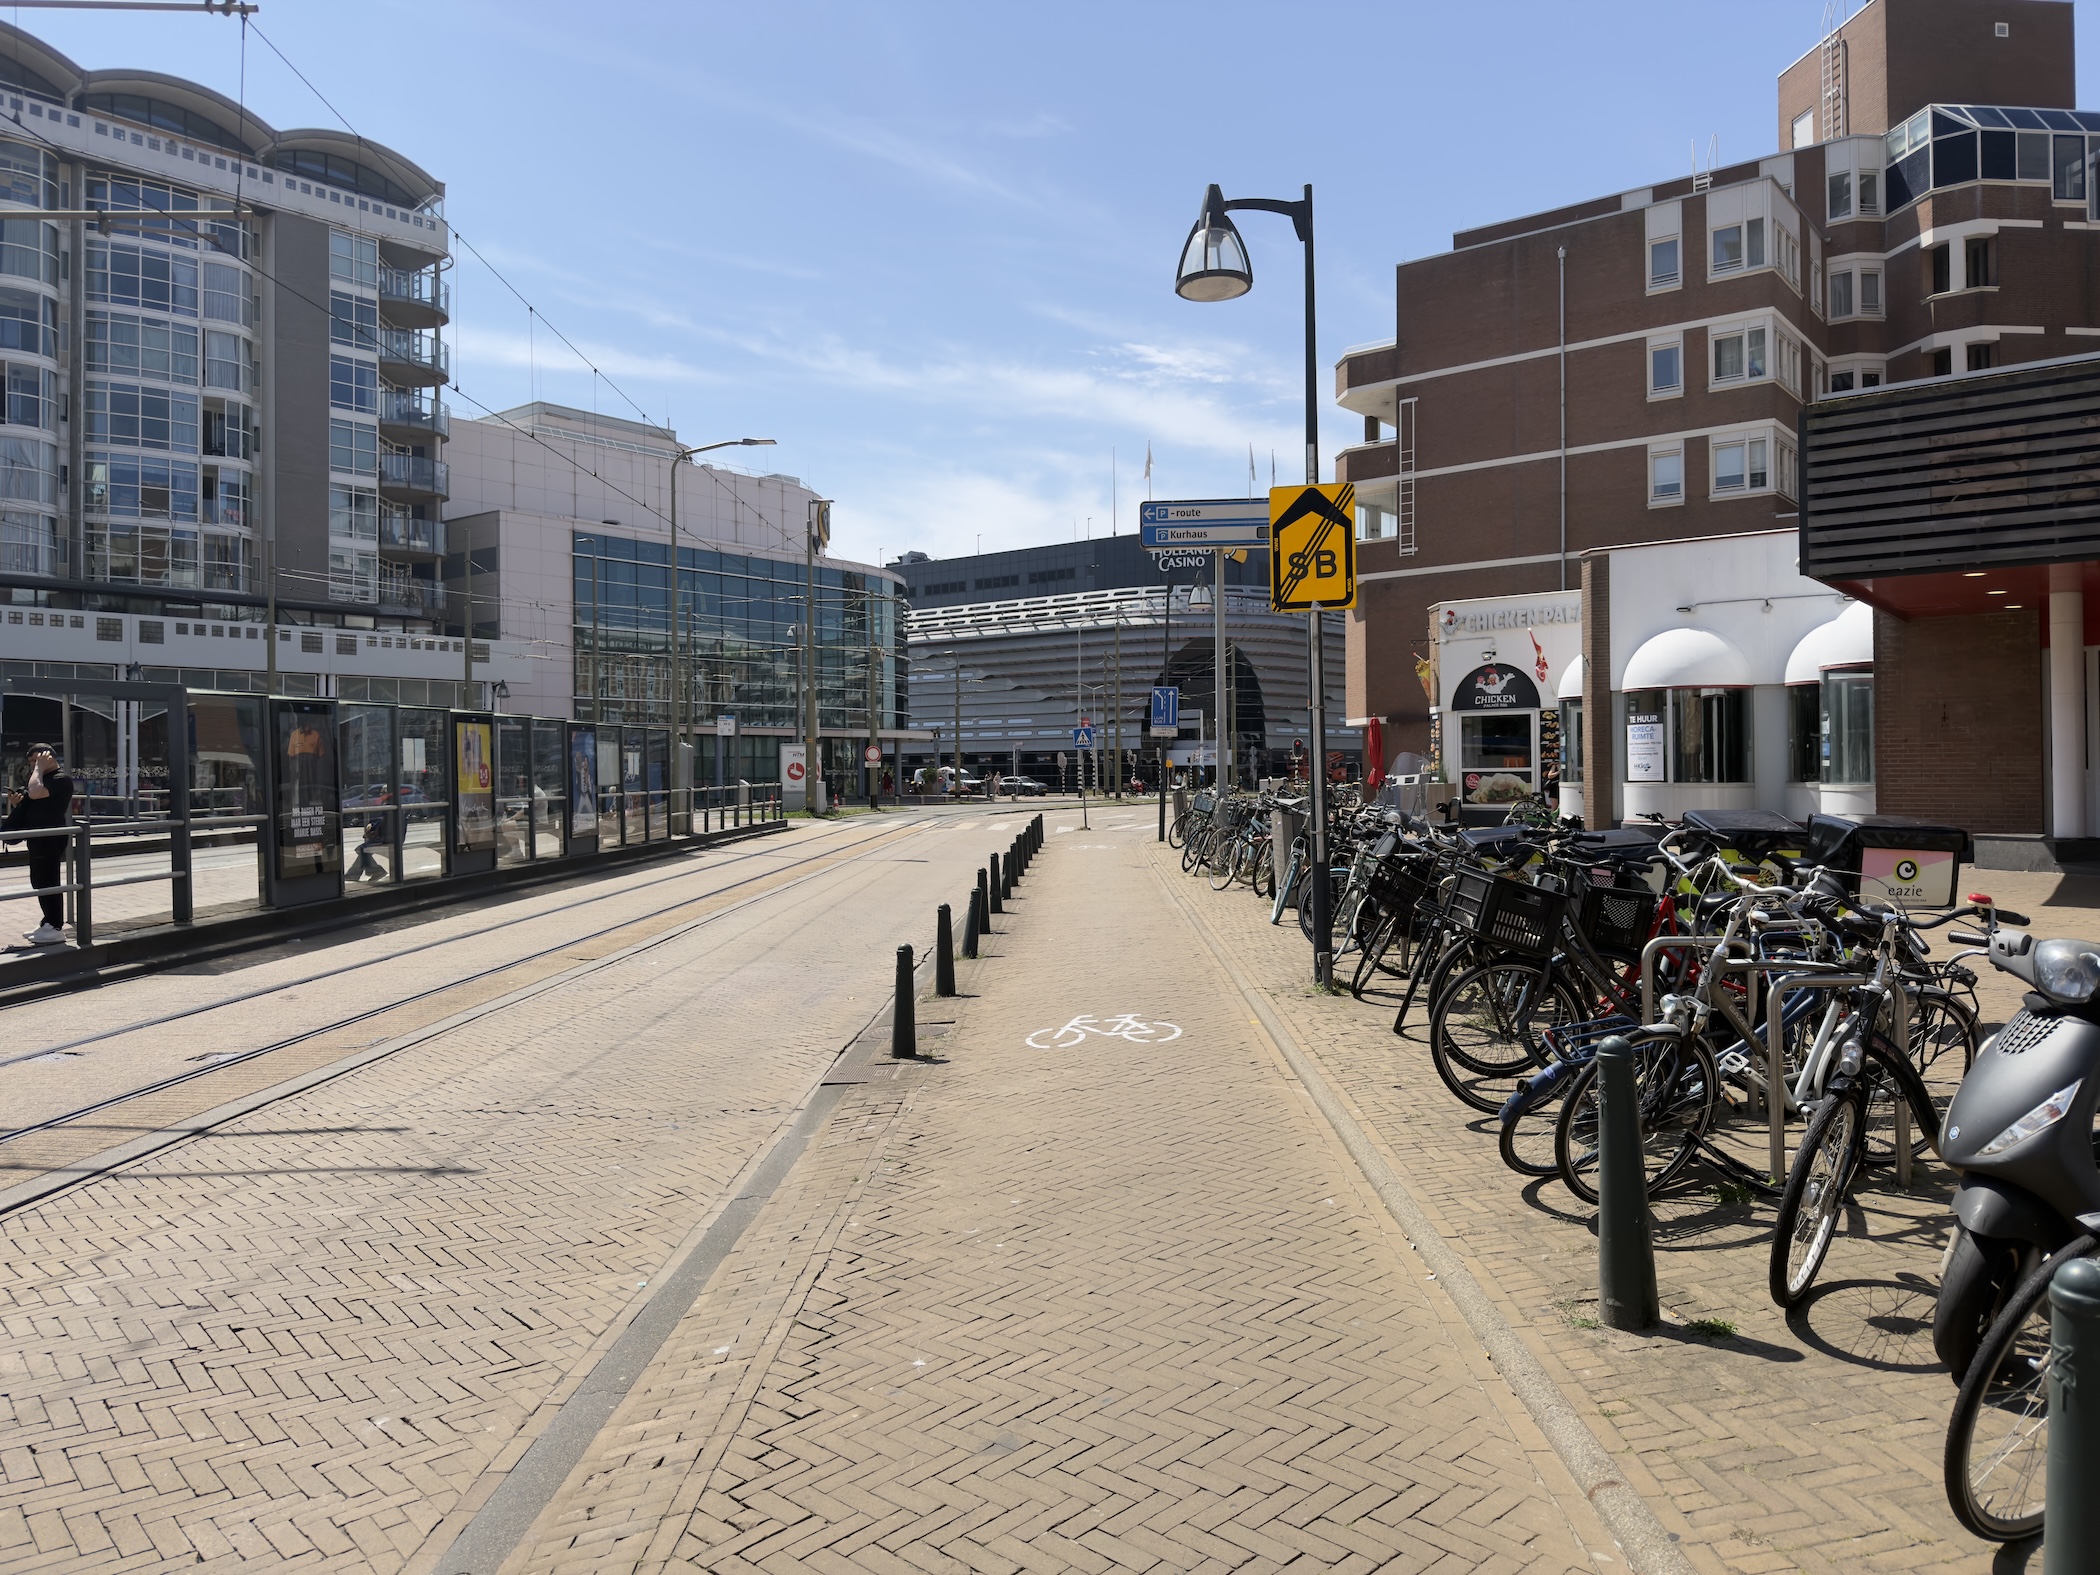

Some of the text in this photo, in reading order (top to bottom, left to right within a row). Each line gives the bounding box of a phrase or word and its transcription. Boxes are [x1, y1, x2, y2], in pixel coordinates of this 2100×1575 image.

[1170, 530, 1208, 539] Kurhaus
[1158, 557, 1206, 572] CASINO
[1464, 608, 1540, 633] CHICKEN
[1474, 694, 1517, 705] CHICKEN
[1629, 714, 1658, 723] TE HUUR
[1630, 725, 1657, 733] HORECA-
[1888, 884, 1923, 896] eazie
[1728, 1005, 1758, 1043] GAZELLE
